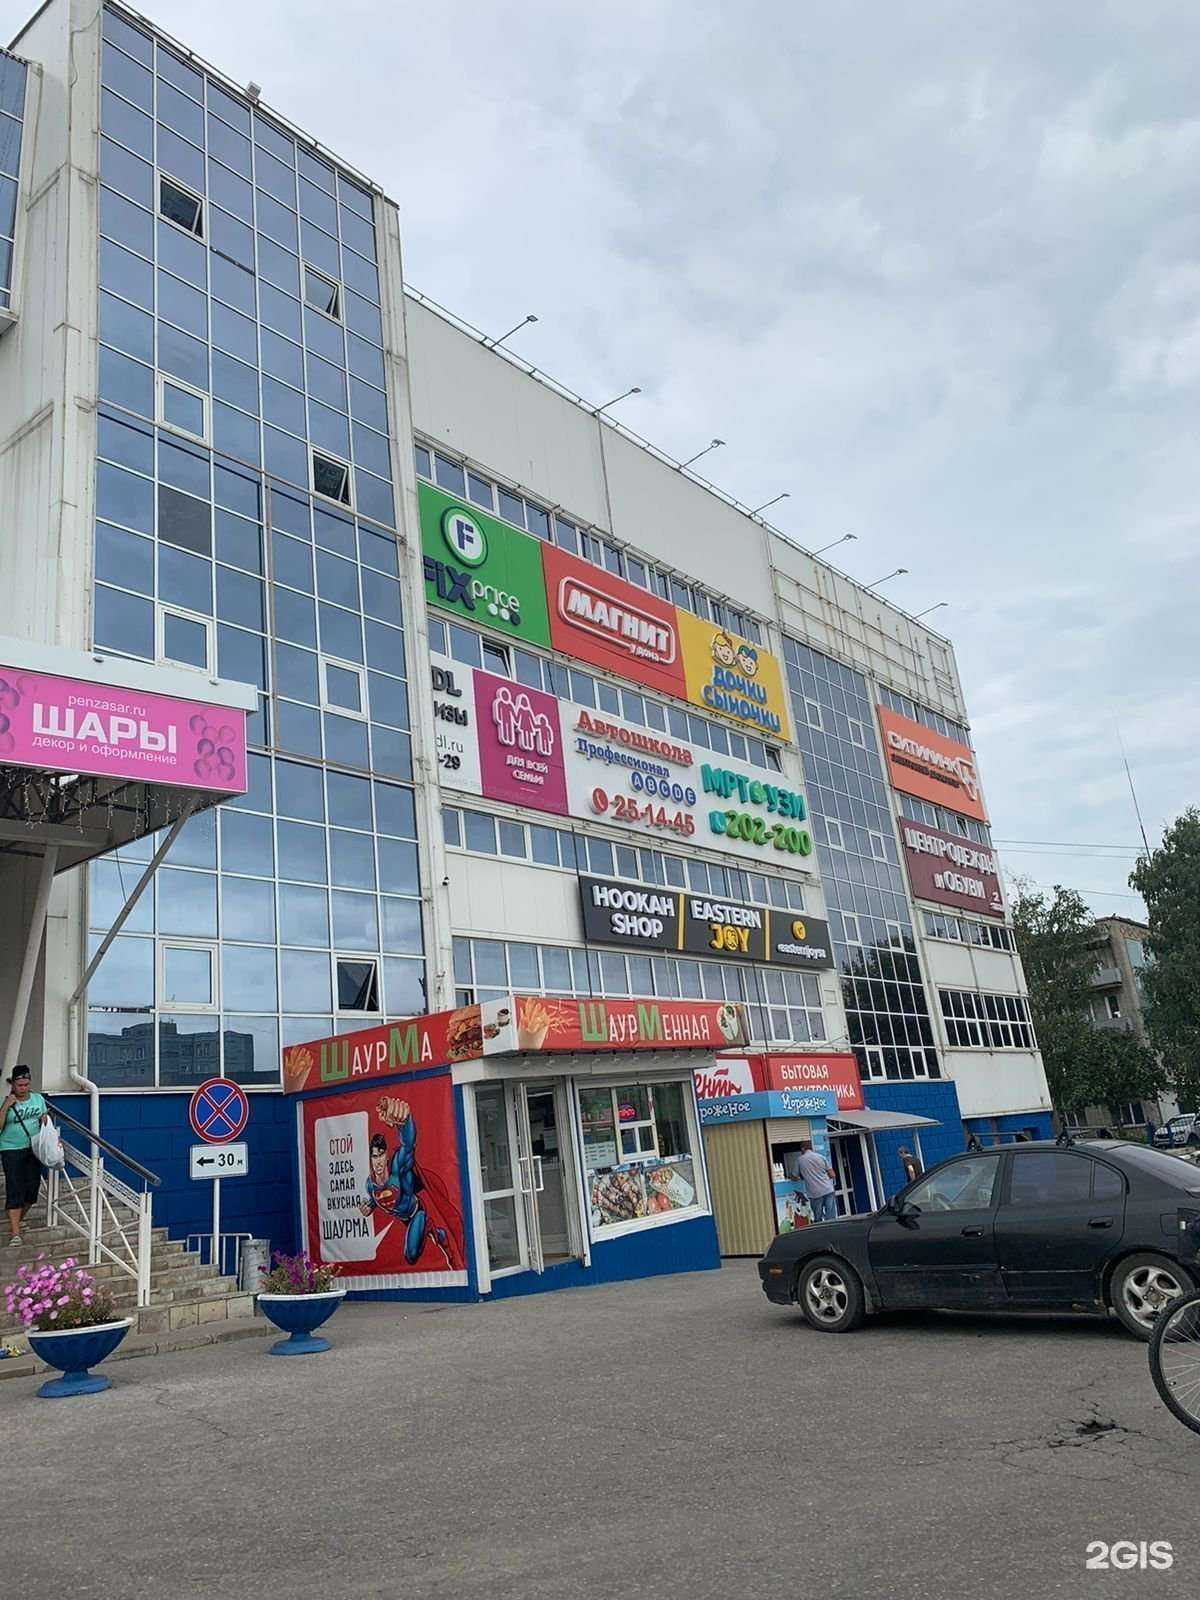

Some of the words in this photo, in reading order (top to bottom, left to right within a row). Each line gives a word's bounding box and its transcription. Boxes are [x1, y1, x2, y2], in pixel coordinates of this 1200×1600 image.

[471, 580, 520, 613] price
[567, 589, 669, 652] МАГНИТ
[68, 694, 146, 717] penzasar.ru
[32, 703, 177, 754] ШАРЫ
[32, 735, 75, 753] декор
[79, 743, 87, 752] и
[92, 743, 177, 765] оформление
[576, 737, 670, 778] Профессионал
[700, 763, 749, 804] МРТ
[762, 784, 807, 822] УЗИ
[725, 810, 812, 856] 202-200
[904, 827, 947, 857] ЦЕНТР
[945, 842, 997, 875] ОДЕЖДЫ
[943, 870, 986, 899] ОБУВИ
[592, 885, 675, 917] HOOKAH
[690, 900, 762, 929] EASTERN
[611, 912, 663, 938] SHOP
[709, 923, 751, 953] JOY
[780, 1064, 829, 1080] БЫТОВАЯ
[329, 1133, 353, 1156] СТОЙ
[218, 1153, 234, 1166] 30
[329, 1159, 354, 1176] ЗДЕСЬ
[330, 1178, 355, 1192] САМАЯ
[327, 1197, 361, 1210] ВКУСНАЯ
[323, 1215, 370, 1240] ШАУРМА
